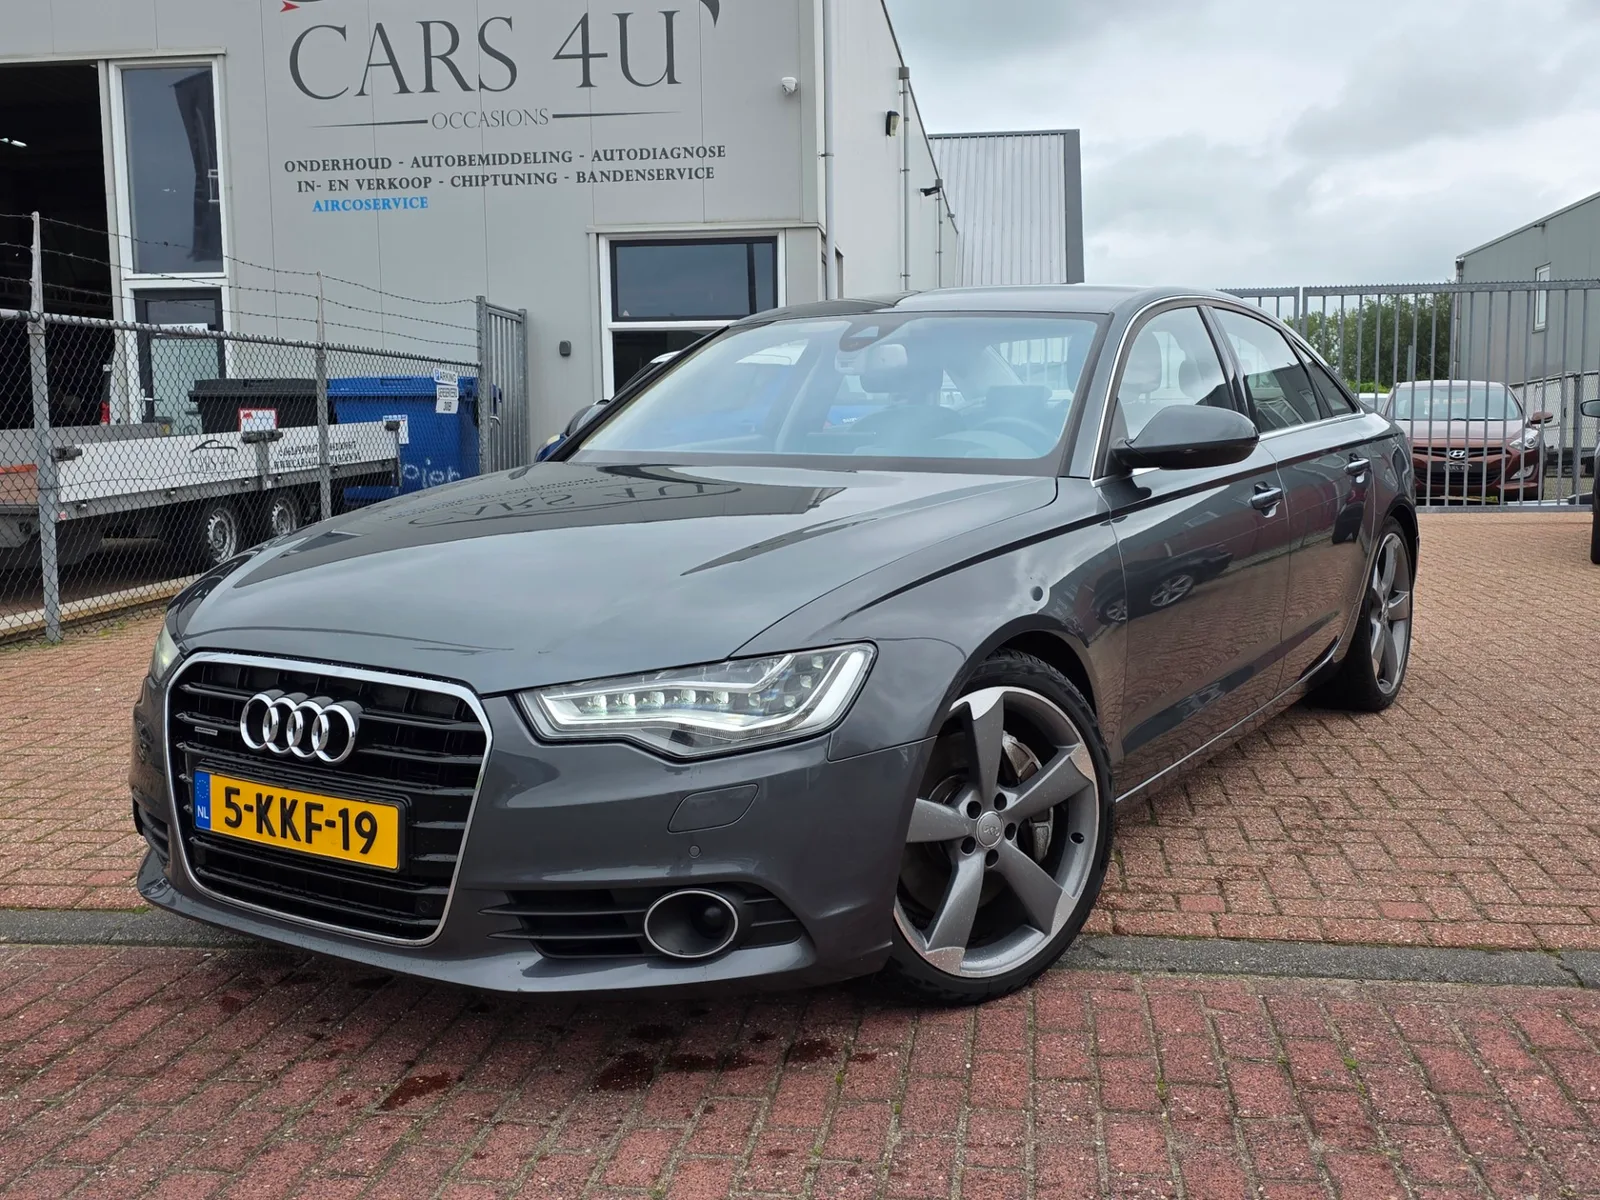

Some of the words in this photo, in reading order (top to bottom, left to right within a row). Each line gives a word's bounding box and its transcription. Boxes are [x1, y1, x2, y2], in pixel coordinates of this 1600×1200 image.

[289, 17, 518, 100] CARS
[552, 10, 682, 88] 4U
[431, 108, 549, 130] OCCASIONS
[284, 157, 392, 173] ONDERHOUD
[410, 150, 573, 169] AUTOBEMIDDELING
[591, 145, 726, 162] AUTODIAGNOSE
[297, 180, 322, 193] IN-
[328, 179, 349, 192] EN
[355, 176, 432, 191] VERKOOP
[450, 172, 558, 187] CHIPTUNING
[576, 167, 715, 184] BANDENSERVICE
[312, 196, 429, 213] AIRCOSERVICE
[197, 805, 209, 820] NL
[224, 786, 378, 855] 5-KKF-19
